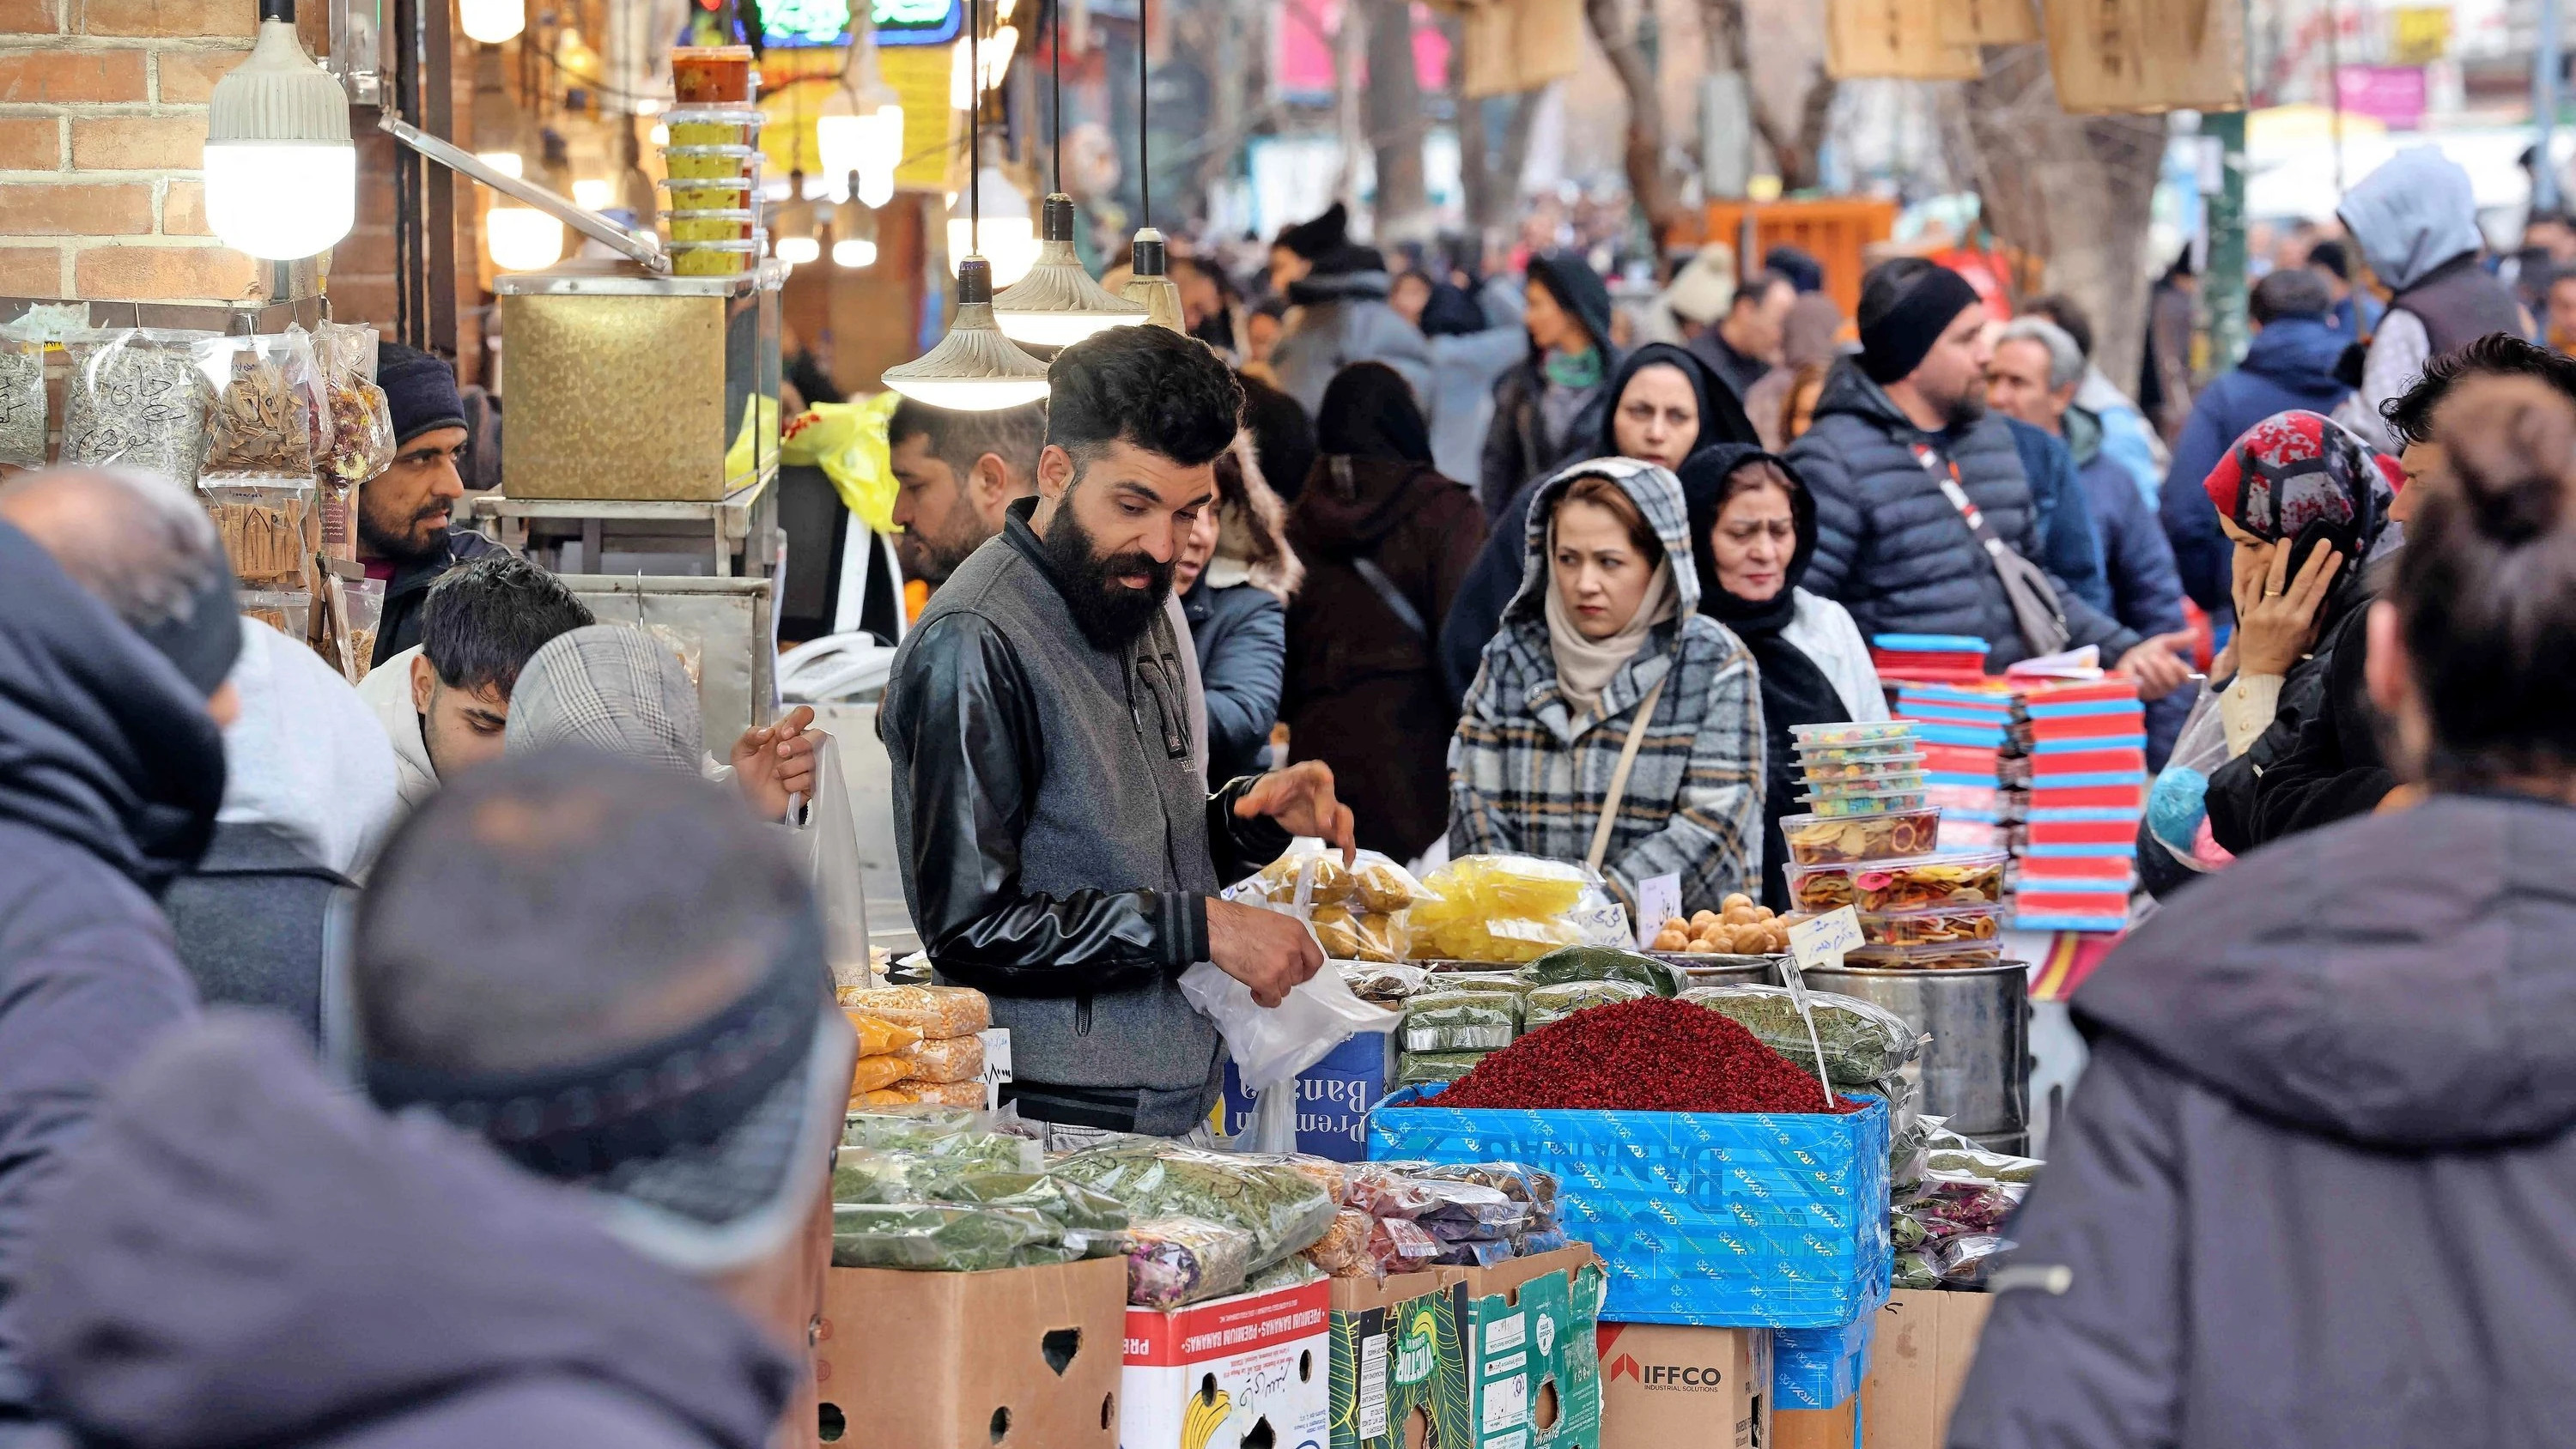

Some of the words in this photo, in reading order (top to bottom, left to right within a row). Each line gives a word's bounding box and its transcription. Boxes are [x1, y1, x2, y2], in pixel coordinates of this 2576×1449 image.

[1239, 1078, 1367, 1113] Bana
[1236, 1114, 1367, 1143] Prem
[1185, 1331, 1223, 1353] BANANAS
[1224, 1324, 1258, 1345] PREMIUM
[1395, 1343, 1435, 1383] VICTOR
[1644, 1366, 1722, 1386] IFFCO
